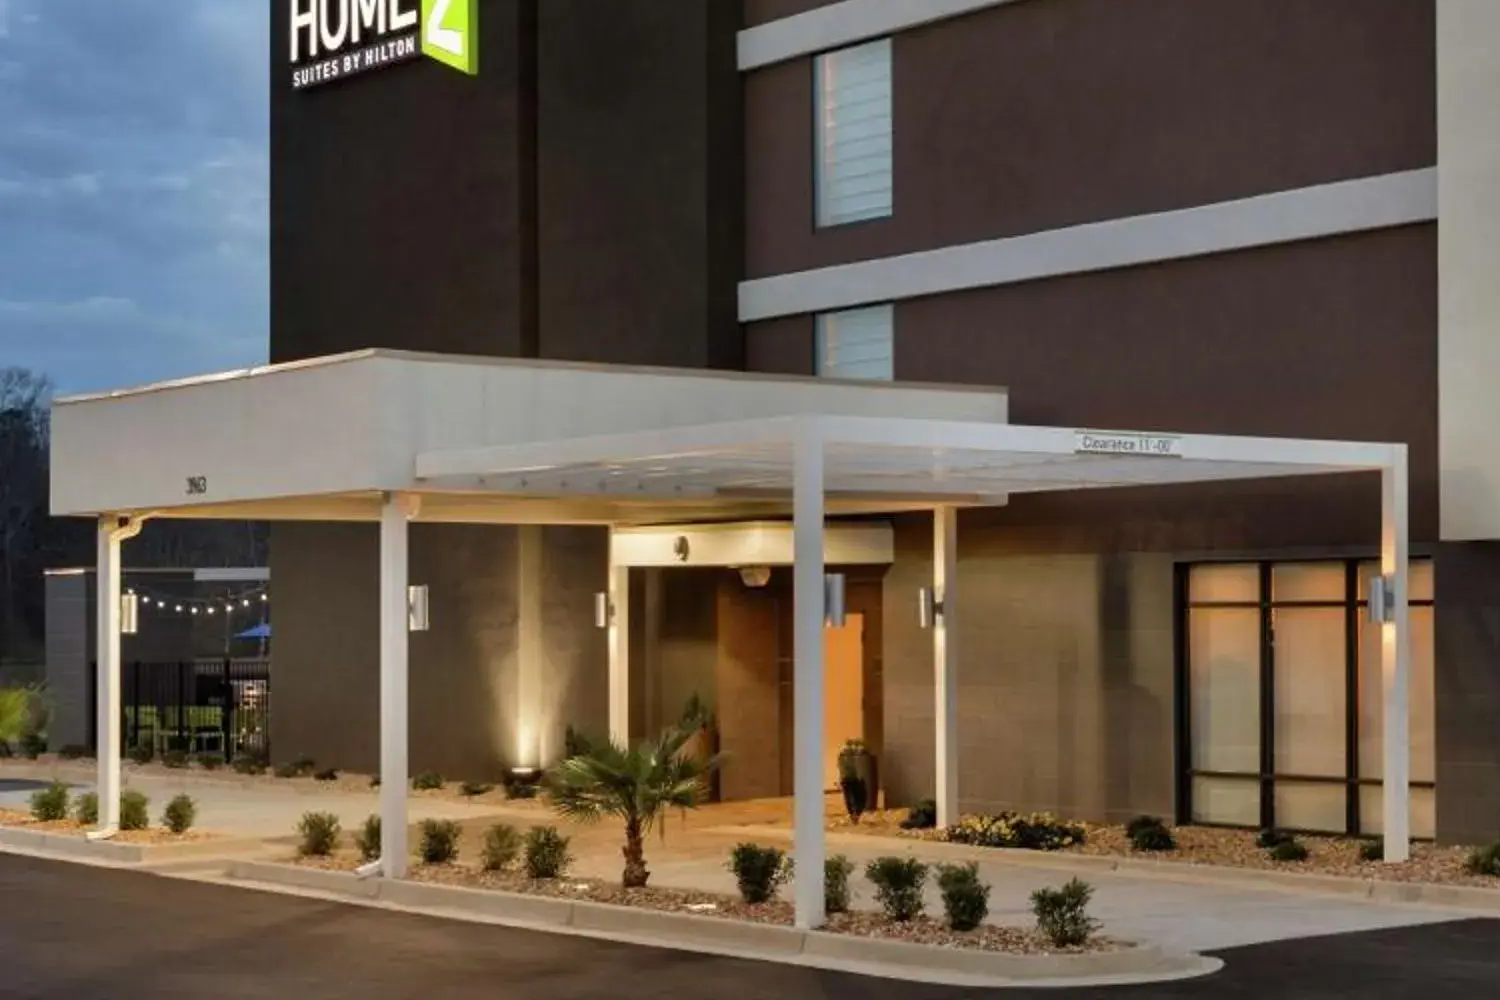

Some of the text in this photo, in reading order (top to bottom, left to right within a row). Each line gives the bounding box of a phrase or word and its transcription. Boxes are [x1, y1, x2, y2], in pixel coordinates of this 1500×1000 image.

[293, 36, 415, 87] SUITES BY HILTON
[1082, 435, 1136, 451] Clearance
